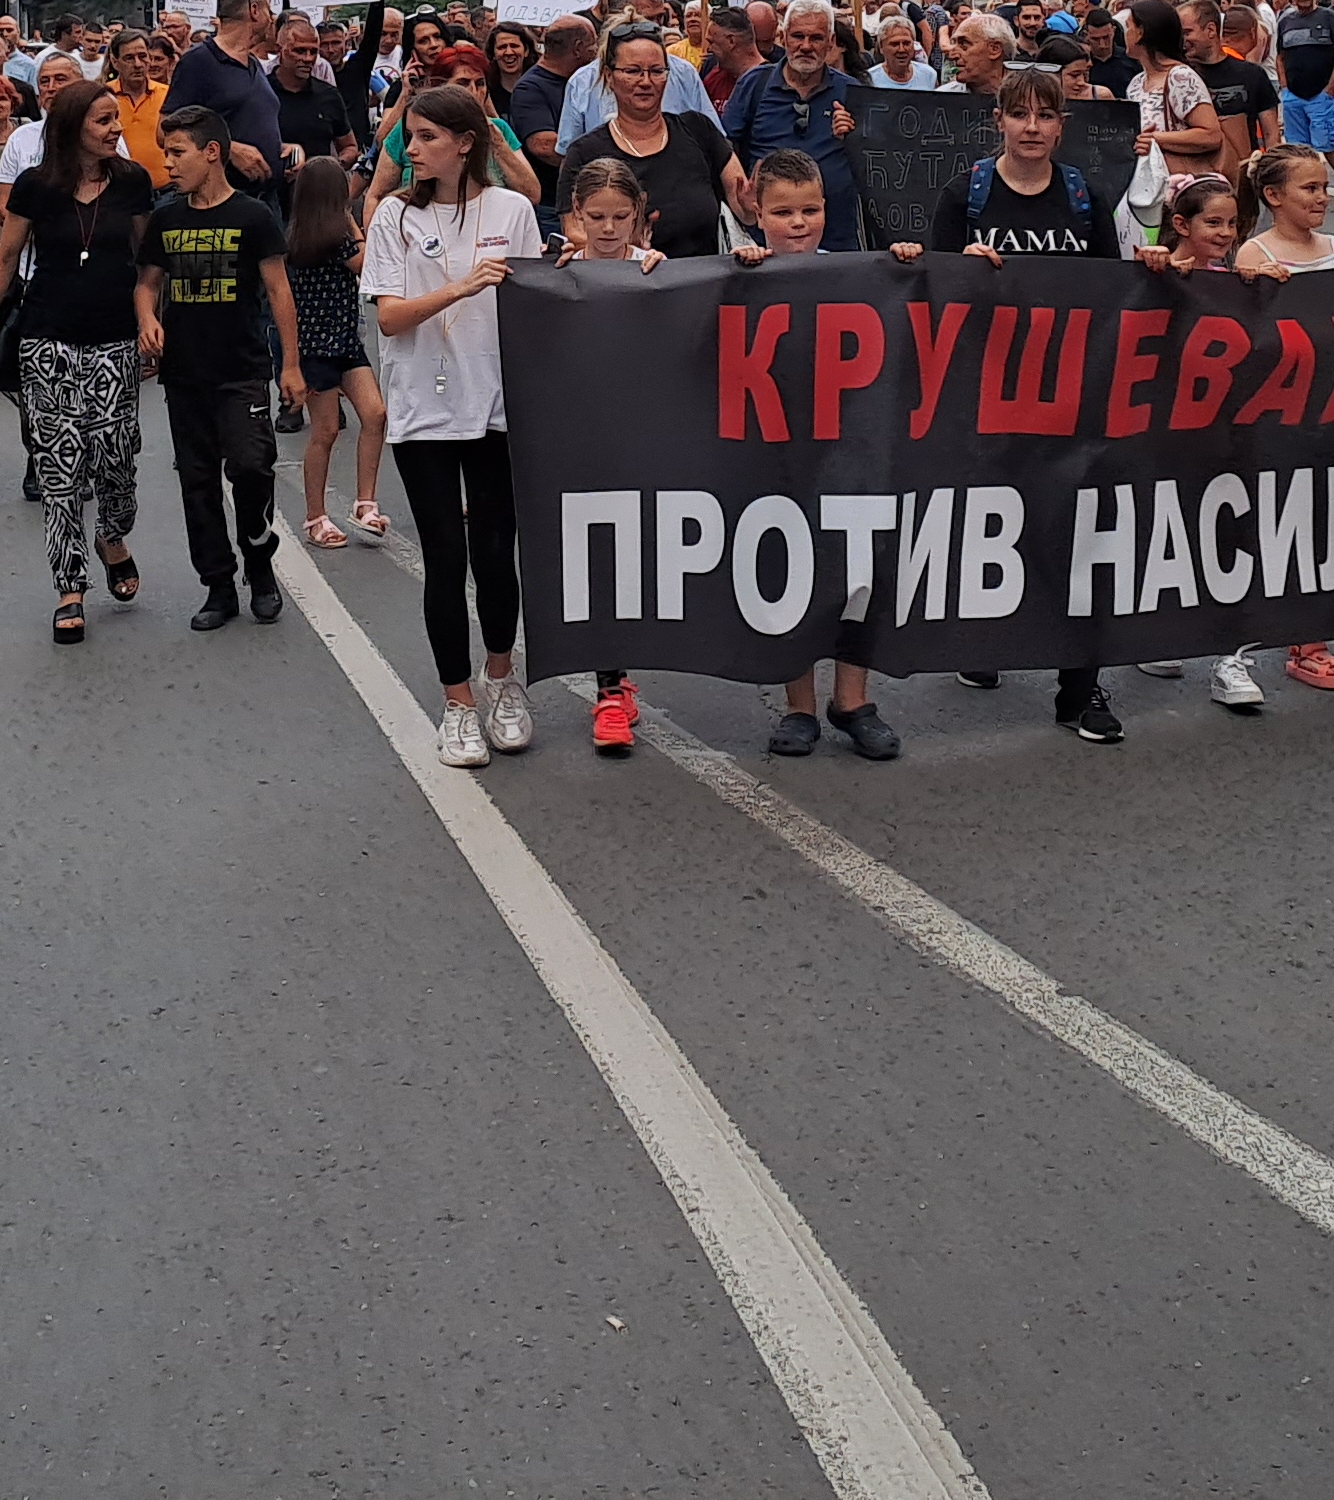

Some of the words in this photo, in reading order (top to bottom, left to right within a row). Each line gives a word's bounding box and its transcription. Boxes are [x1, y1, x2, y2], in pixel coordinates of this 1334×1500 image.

[862, 104, 1002, 146] ГОДИ
[862, 149, 992, 190] ЋУТА
[161, 228, 242, 253] MUSIC
[560, 485, 1026, 637] ПРОТИВ
